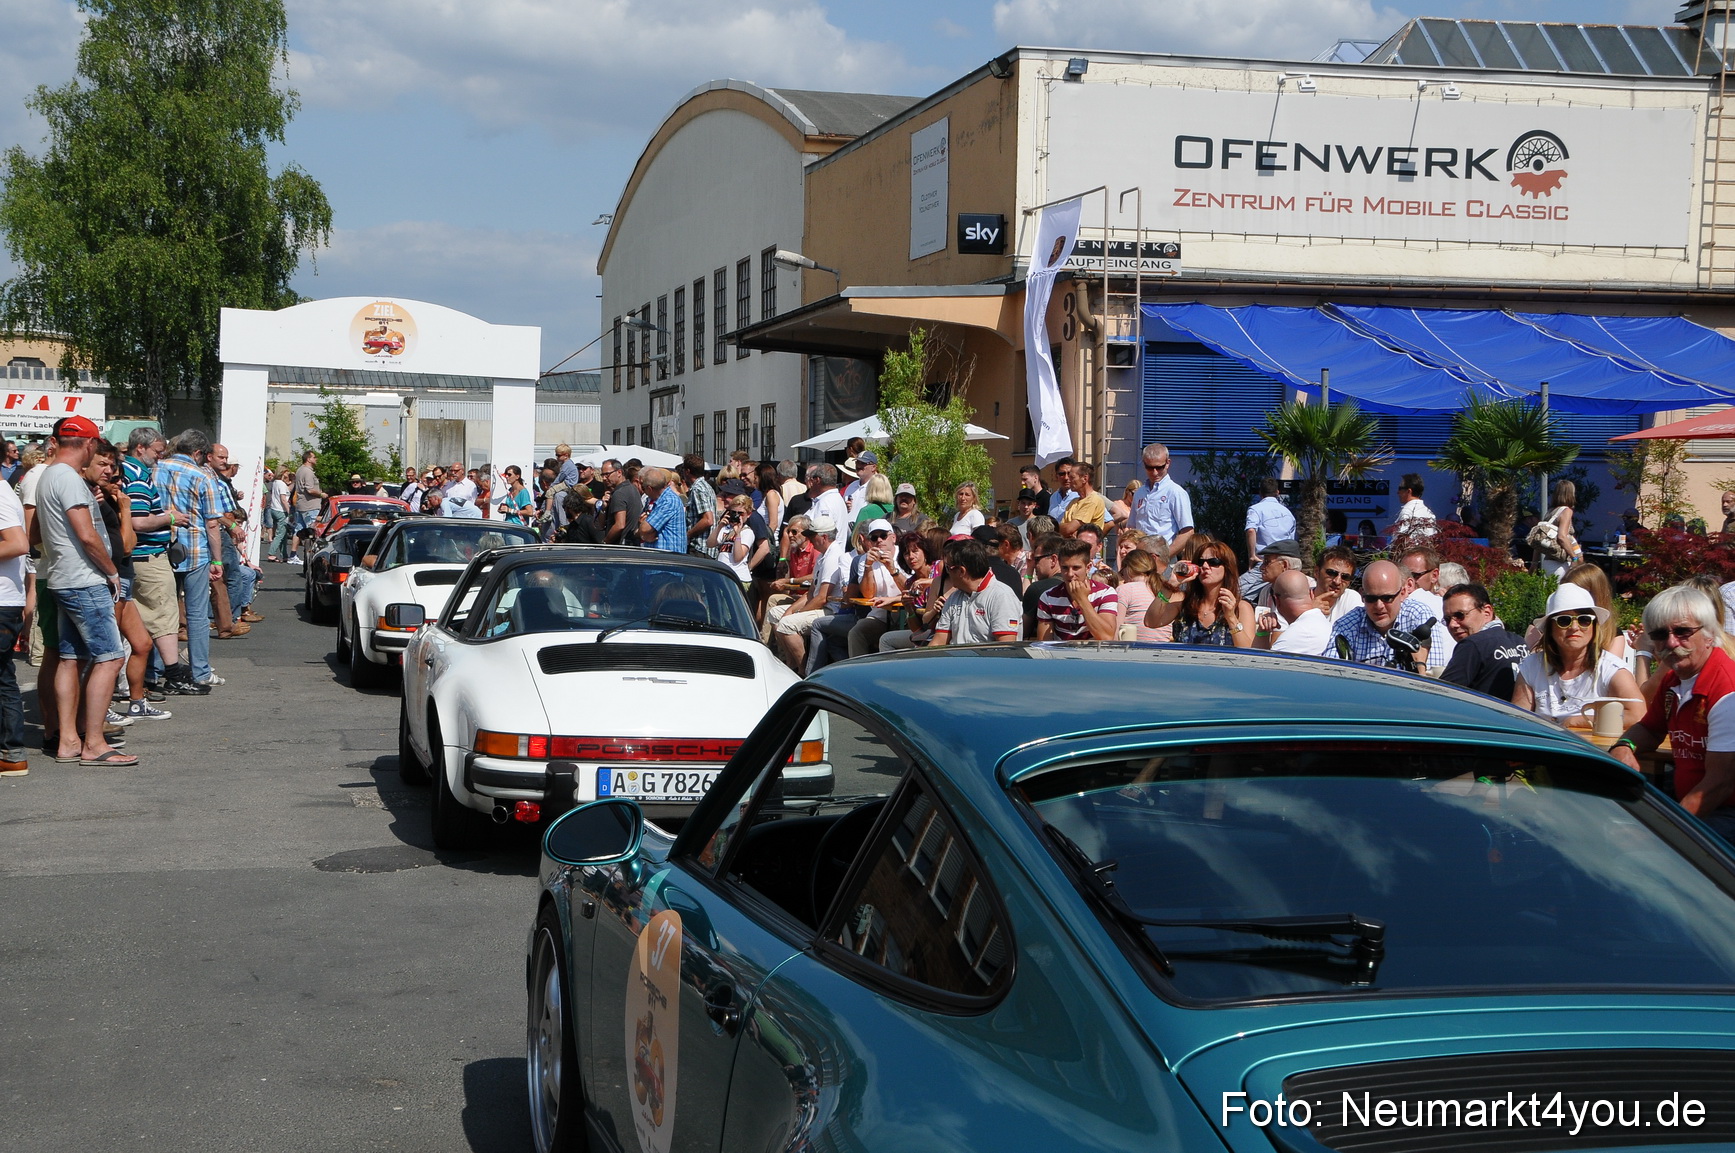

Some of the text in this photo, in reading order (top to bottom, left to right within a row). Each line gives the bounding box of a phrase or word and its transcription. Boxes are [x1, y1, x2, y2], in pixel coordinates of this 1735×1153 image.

[1174, 134, 1500, 182] OFENWERK
[1173, 188, 1569, 220] ZENTRUM FÜR MOBILE CLASSIC
[965, 222, 999, 245] sky
[1077, 239, 1161, 251] ENWERK
[1065, 257, 1172, 270] AUPTEINGANG
[373, 304, 395, 317] ZIEL
[1063, 292, 1076, 342] 3
[661, 772, 716, 793] 7826
[651, 919, 677, 972] 37
